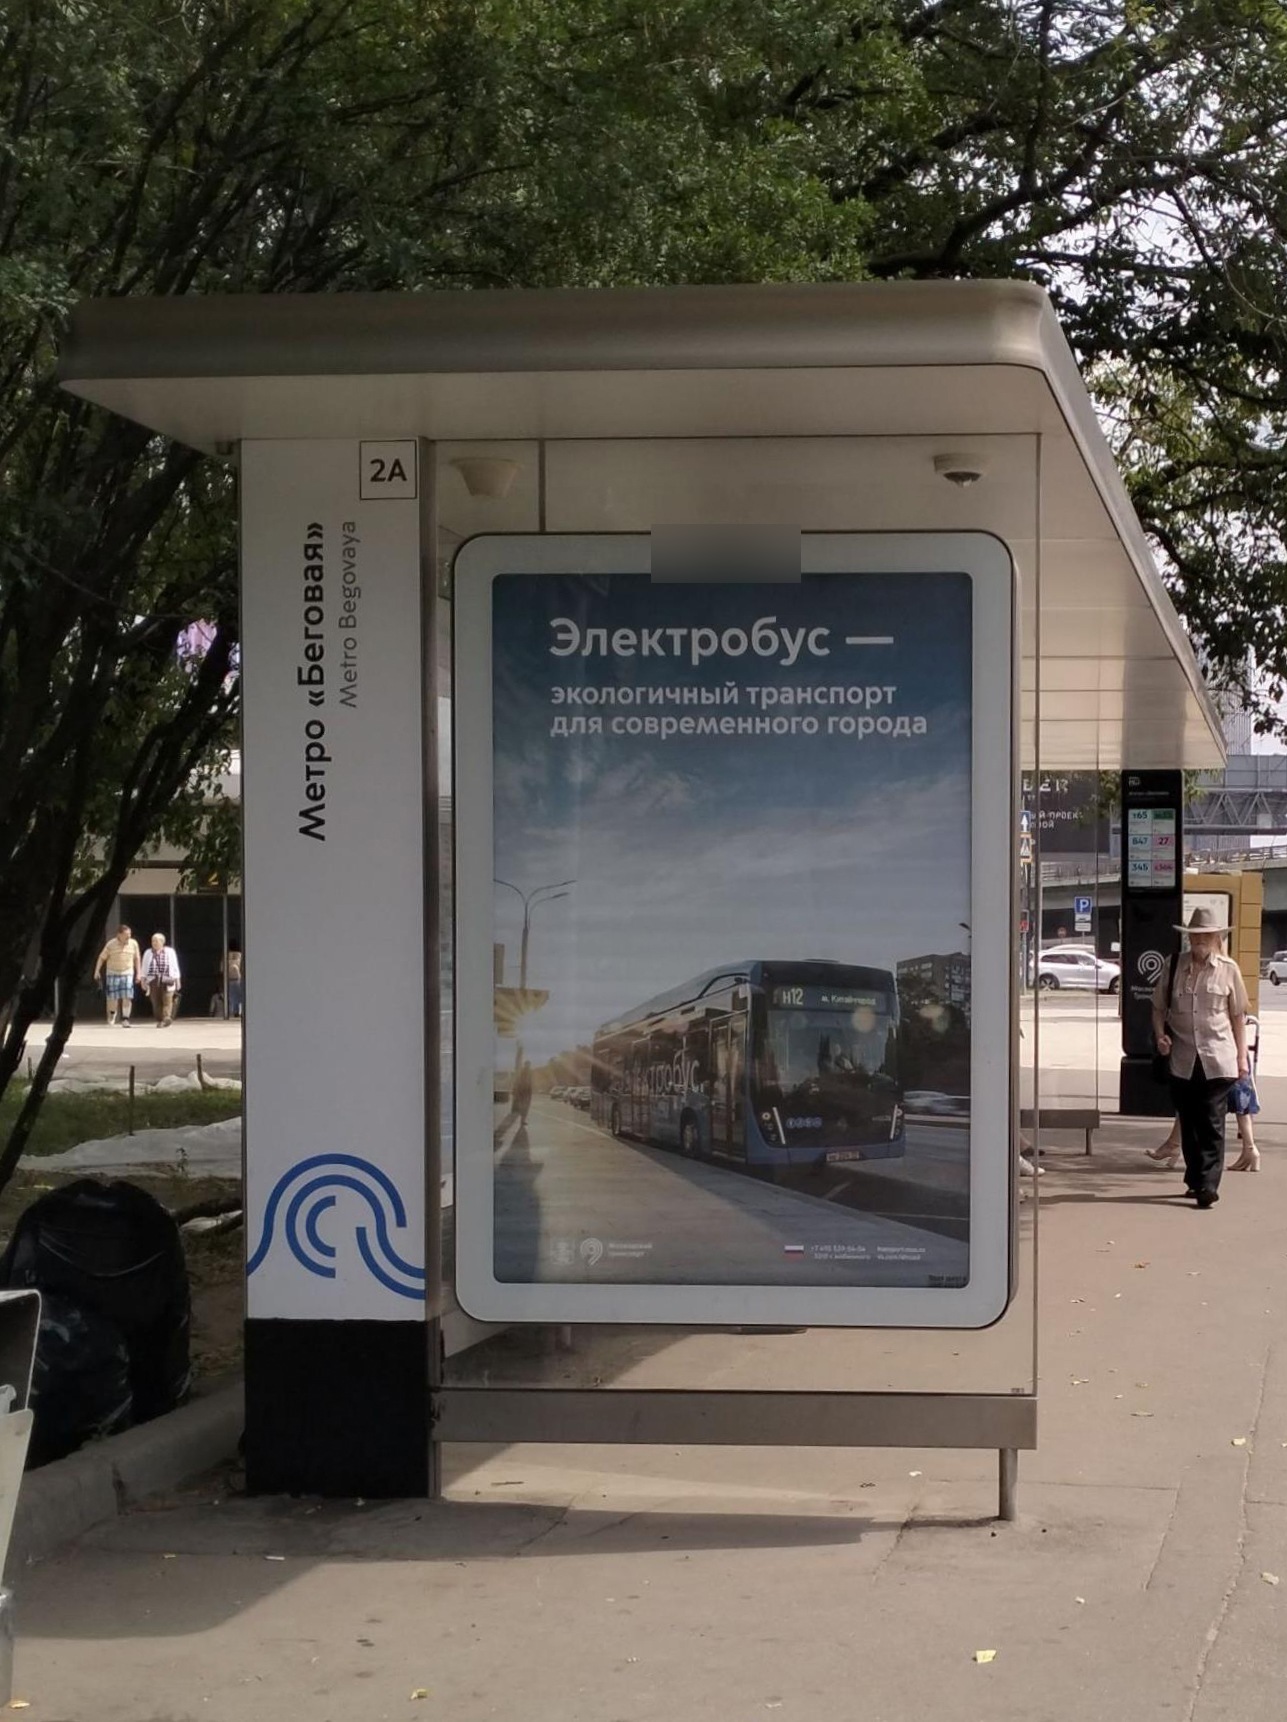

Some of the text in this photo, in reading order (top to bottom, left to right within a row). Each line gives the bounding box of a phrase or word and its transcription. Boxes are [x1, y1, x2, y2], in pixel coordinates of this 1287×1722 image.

[370, 458, 408, 483] 2A
[339, 520, 361, 708] Metro Begovaya
[550, 616, 831, 665] Электробус
[298, 522, 332, 841] Метро «Беговая»
[550, 681, 897, 709] экологичный транспорт
[549, 714, 928, 740] для современного города
